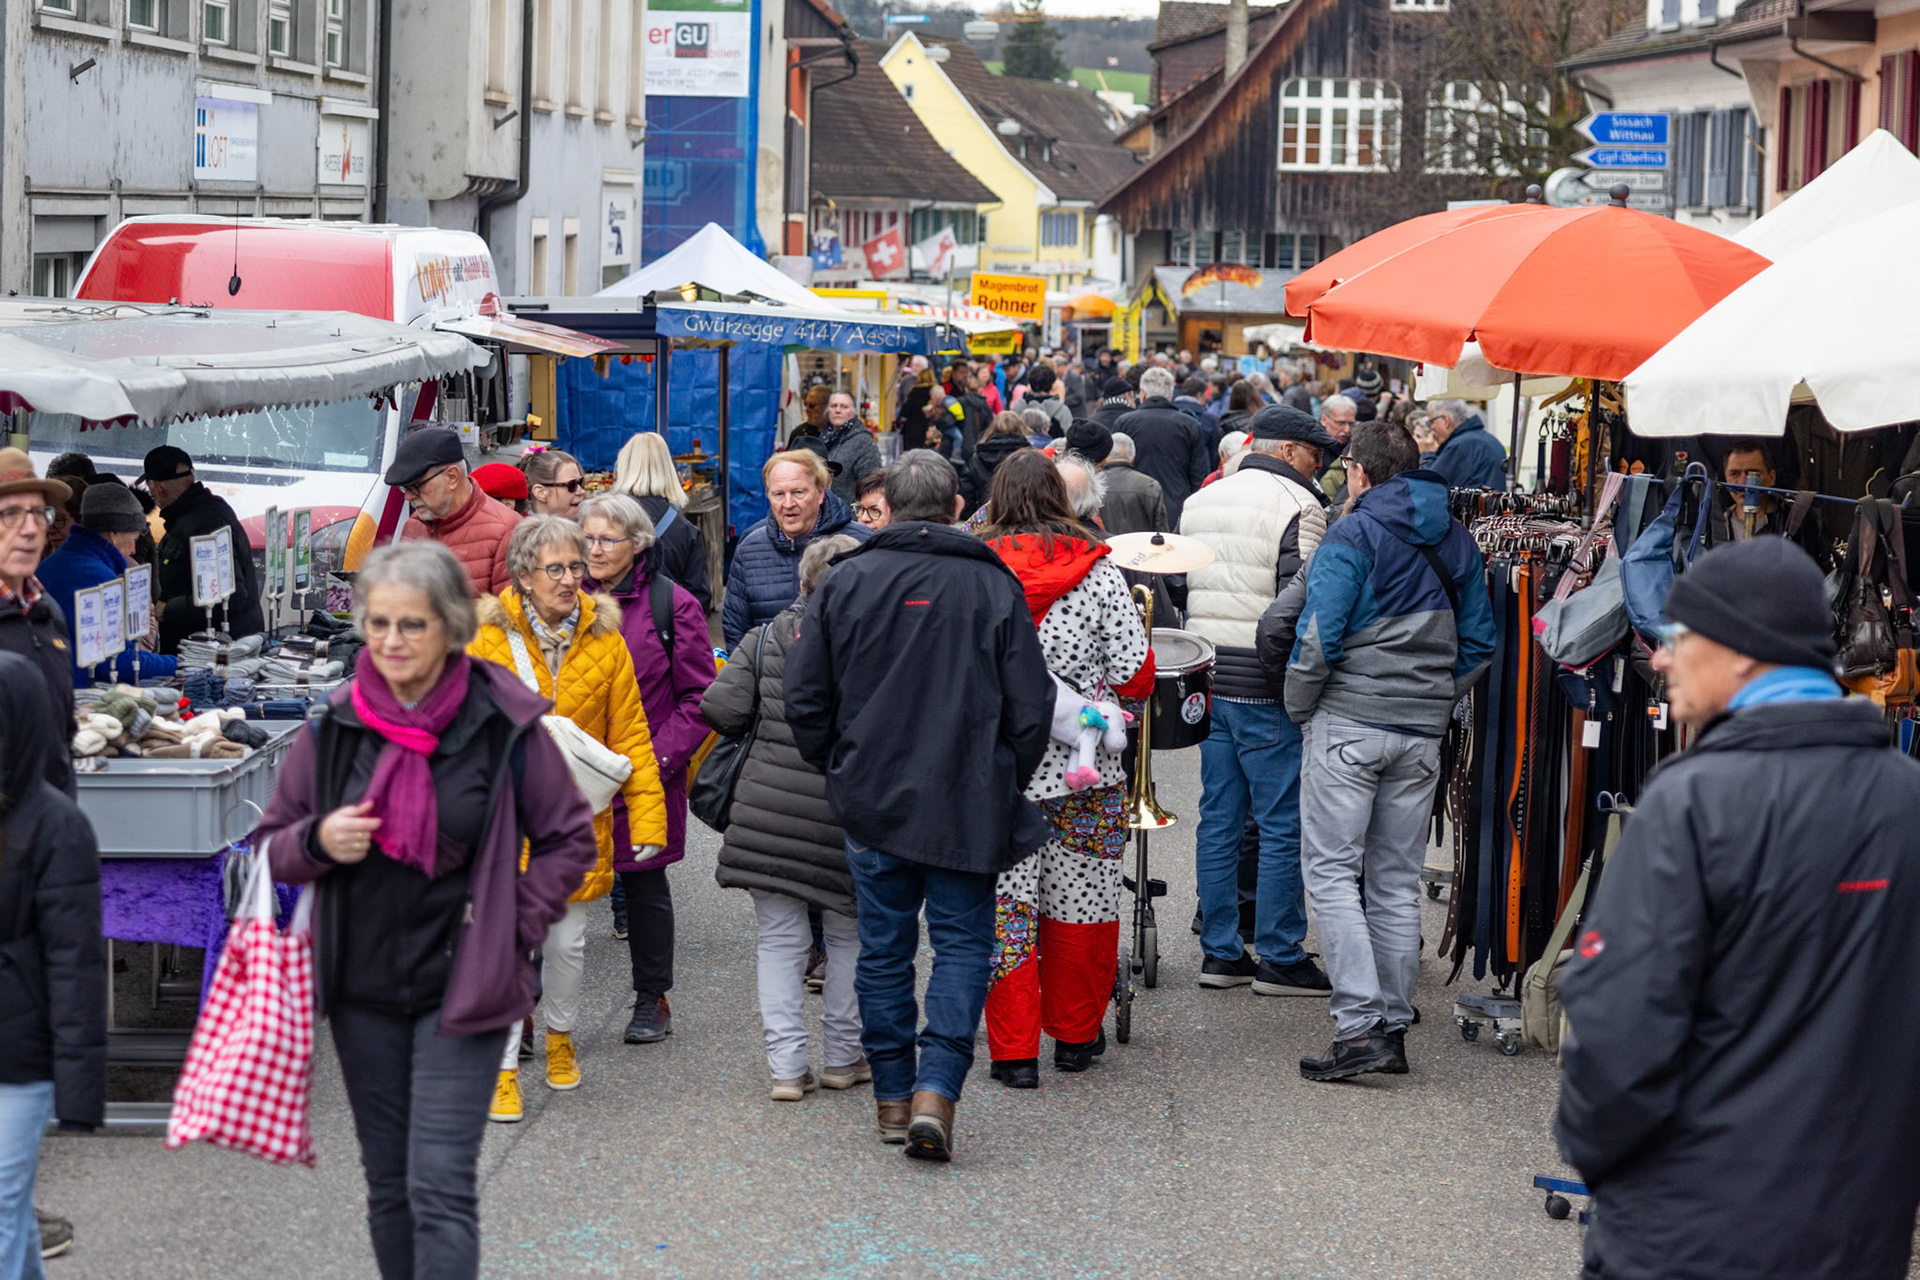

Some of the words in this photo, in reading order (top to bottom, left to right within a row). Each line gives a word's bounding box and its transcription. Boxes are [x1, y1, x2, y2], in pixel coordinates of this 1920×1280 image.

[677, 25, 707, 46] GU
[1612, 115, 1653, 128] Sissach
[1610, 129, 1655, 141] Wittnau
[208, 135, 228, 168] LOFT
[979, 279, 1038, 293] Magenbrot
[978, 295, 1037, 314] Rohner
[684, 314, 784, 342] Gwürzegge
[793, 321, 843, 342] 4147
[846, 326, 907, 348] Aesch
